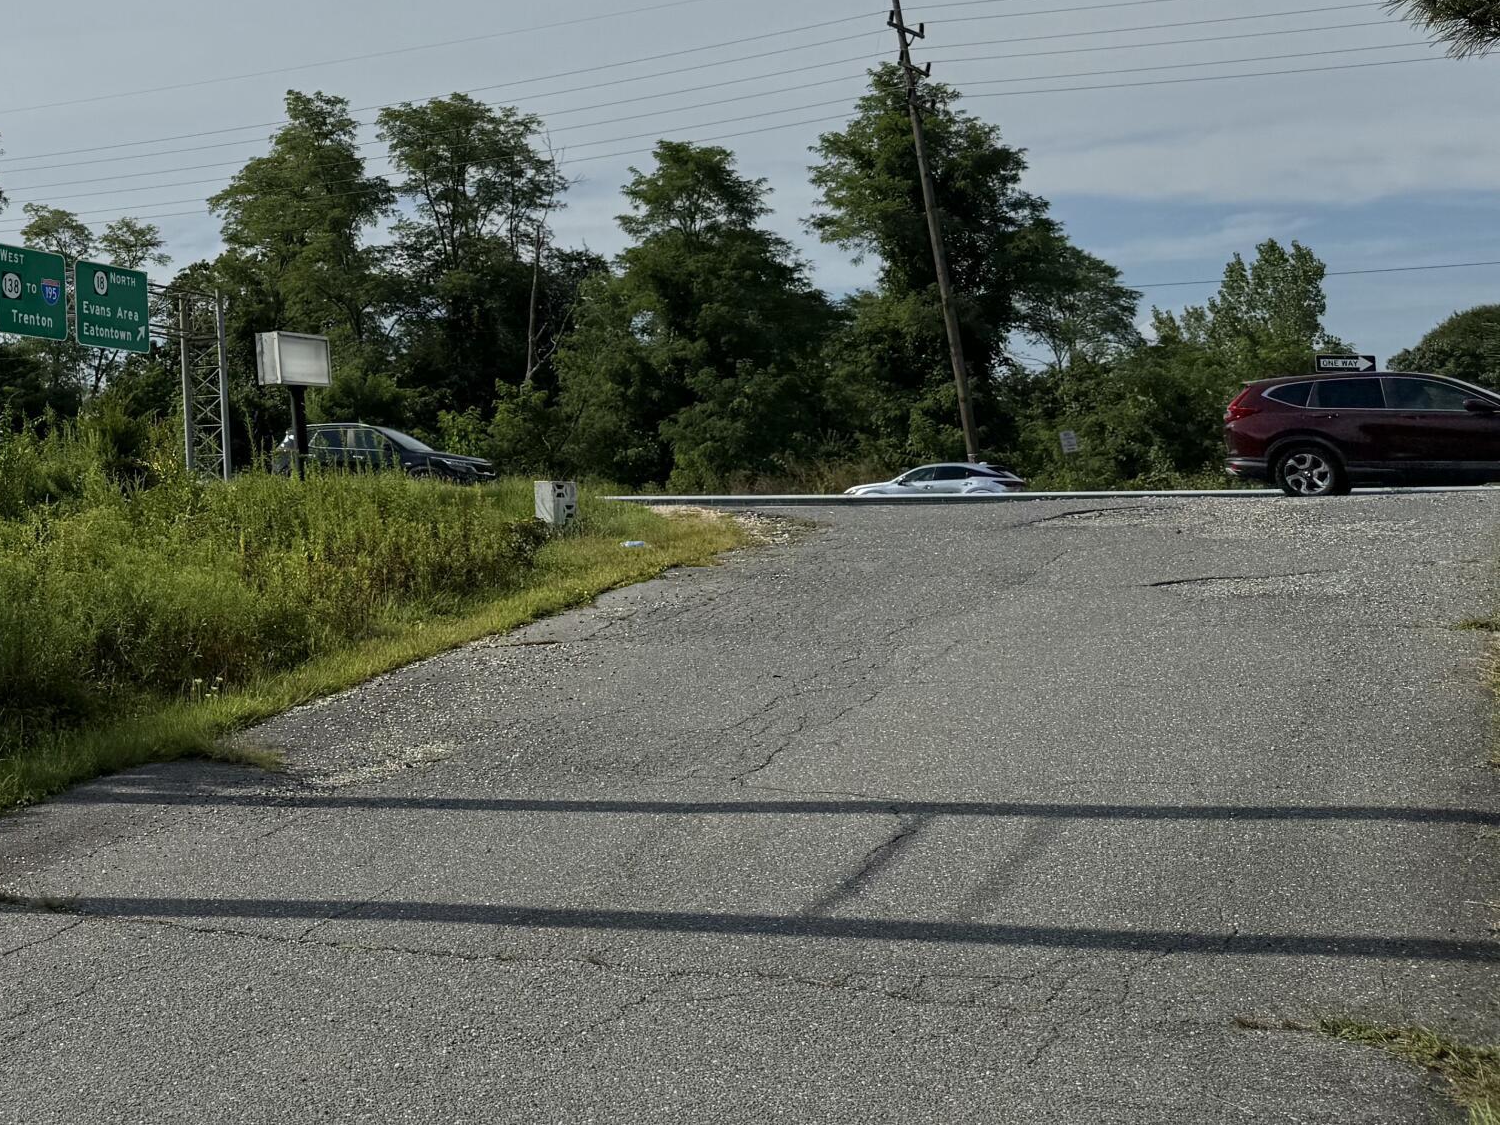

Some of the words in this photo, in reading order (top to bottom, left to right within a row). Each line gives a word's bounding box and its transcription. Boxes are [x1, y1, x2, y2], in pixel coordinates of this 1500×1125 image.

[0, 249, 25, 264] WEST
[4, 277, 20, 294] 138
[26, 283, 37, 294] TO
[45, 286, 57, 300] 195
[110, 271, 136, 287] NORTH
[12, 309, 53, 328] Trenton
[83, 300, 112, 317] Evans
[116, 306, 139, 321] Area
[83, 322, 132, 341] Eatontown
